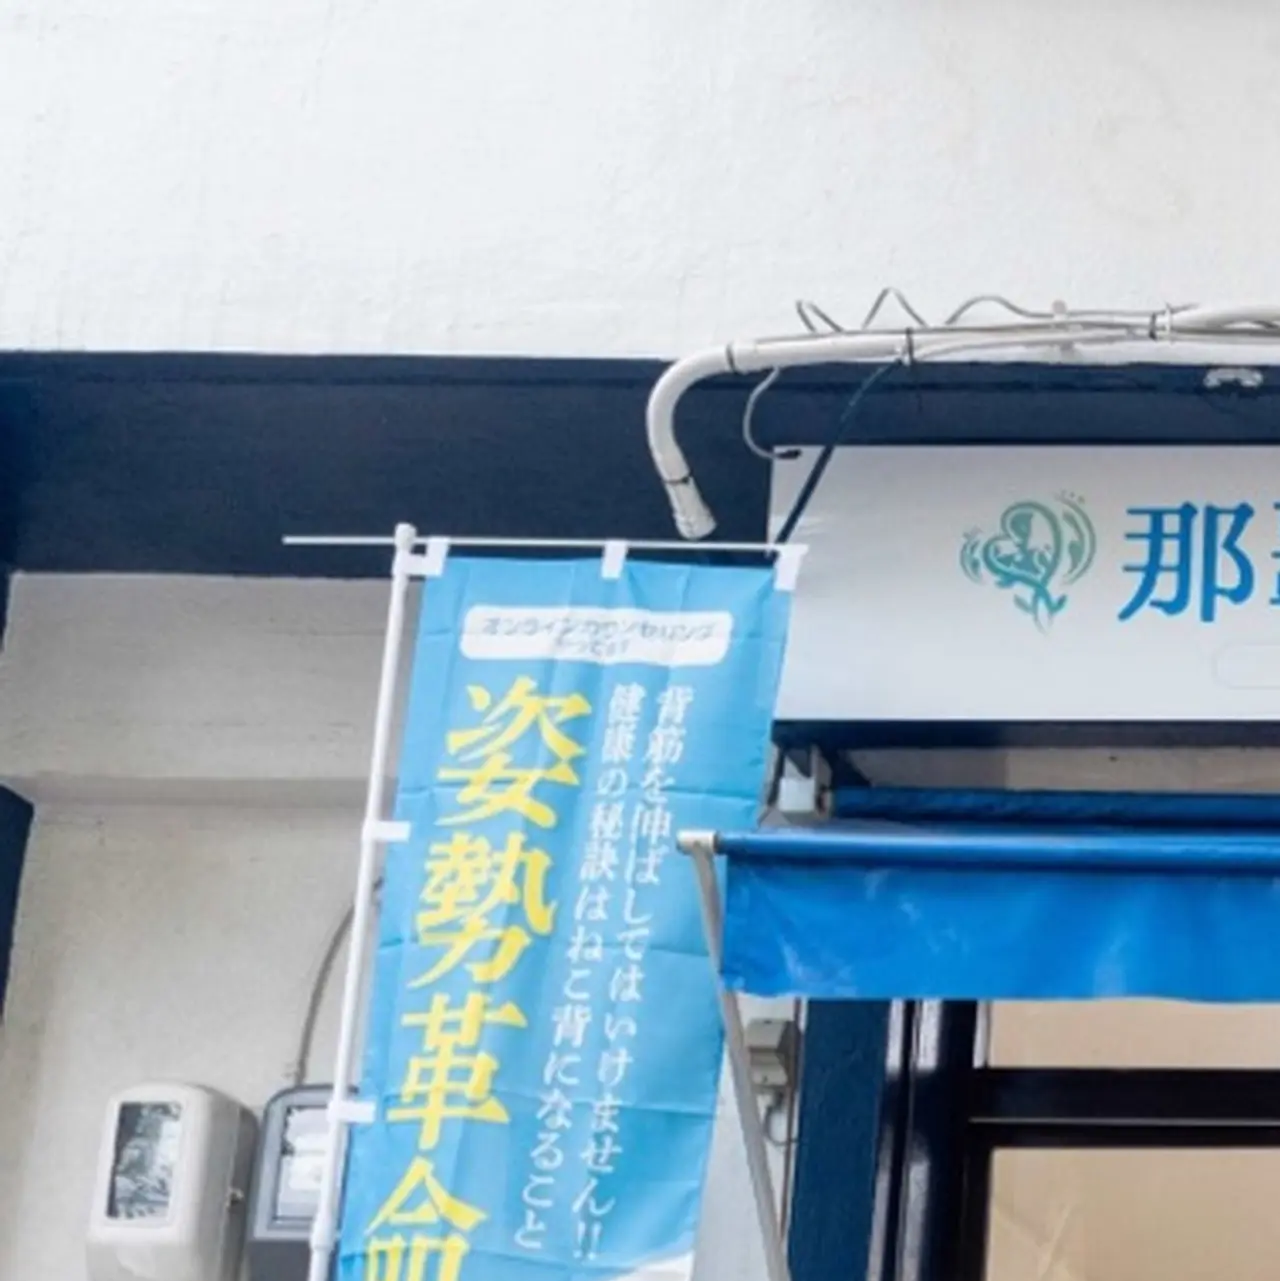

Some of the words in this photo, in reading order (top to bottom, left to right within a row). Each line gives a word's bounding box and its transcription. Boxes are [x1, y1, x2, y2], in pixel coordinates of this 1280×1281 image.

[513, 681, 646, 1250] 健康の秘訣はねこ背になること
